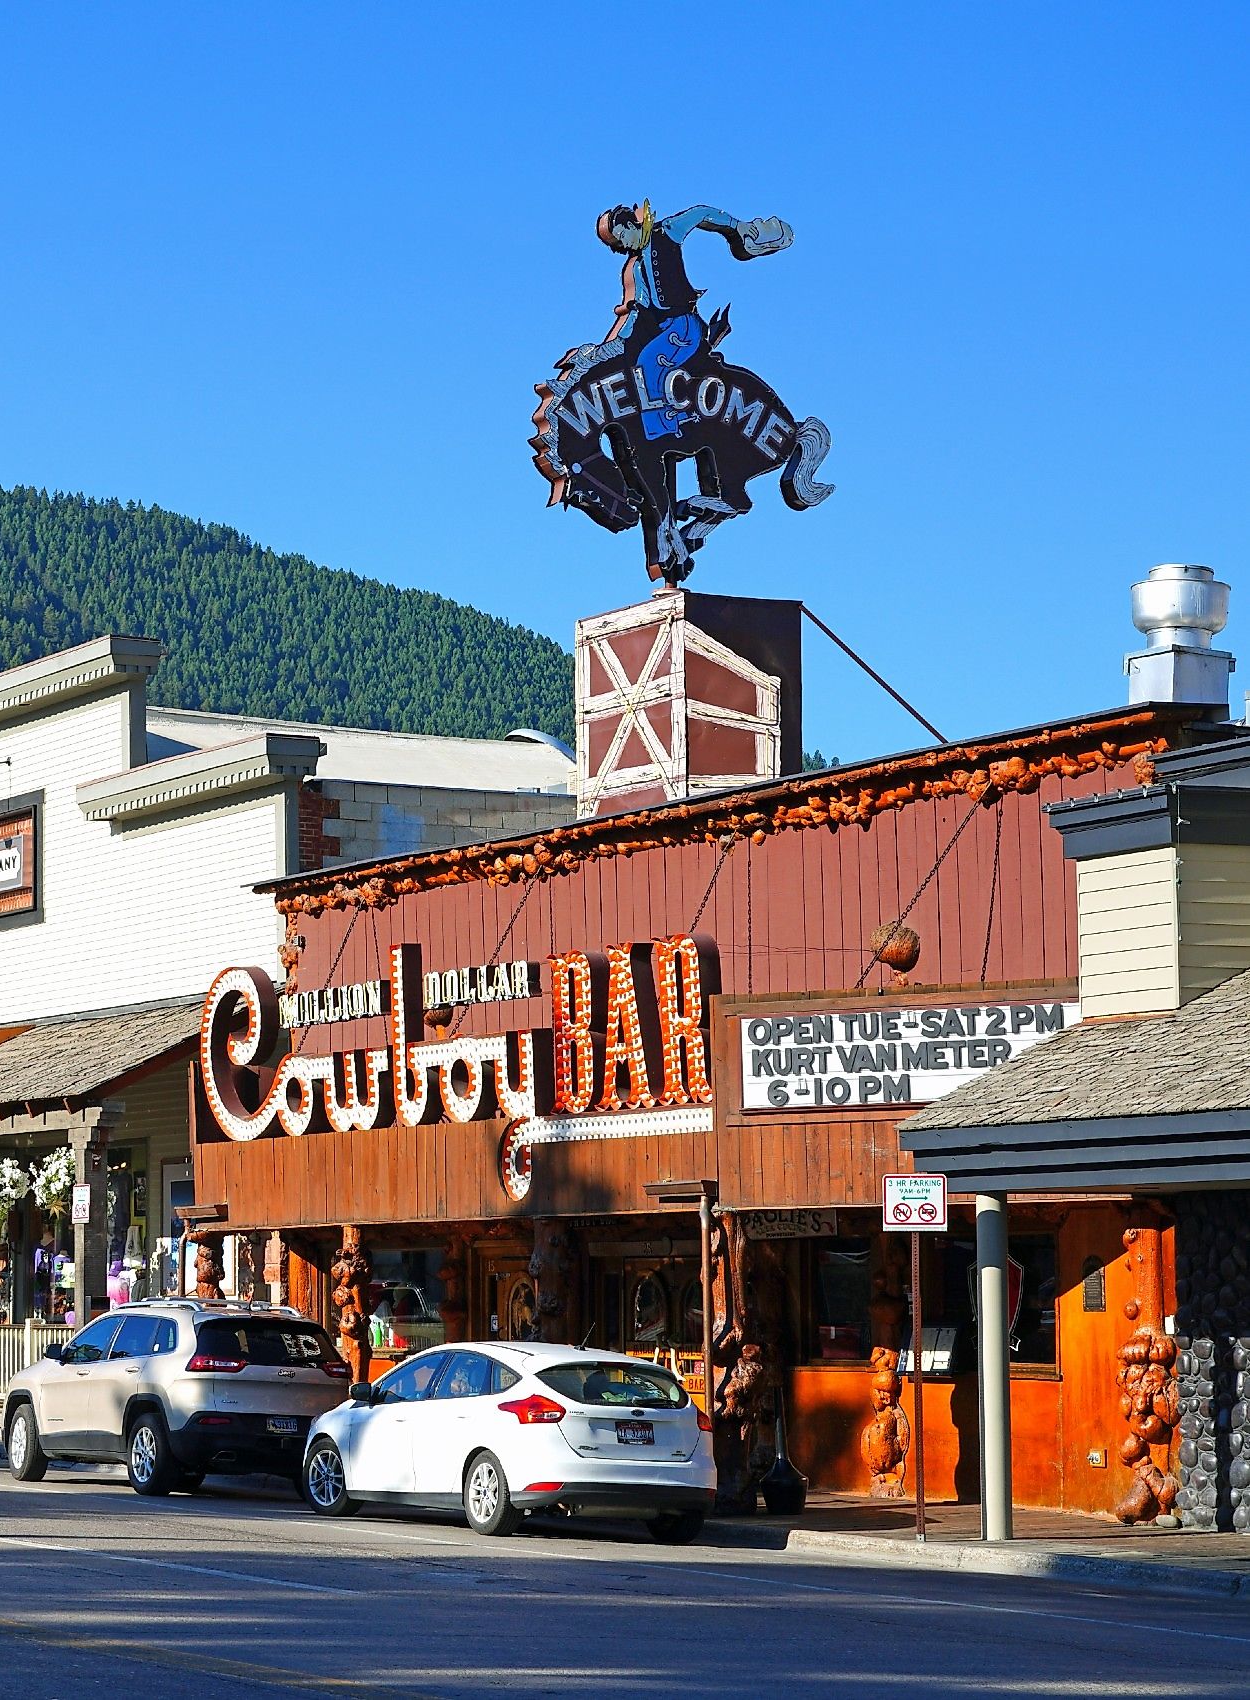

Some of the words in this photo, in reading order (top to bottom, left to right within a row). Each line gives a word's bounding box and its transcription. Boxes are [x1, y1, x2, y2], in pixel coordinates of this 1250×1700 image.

[556, 367, 798, 460] WELCOME
[279, 980, 382, 1029] MILLION
[422, 959, 530, 1009] DOLLAR
[549, 933, 715, 1113] BAR
[747, 1015, 834, 1046] OPEN
[751, 1046, 831, 1077] KURT
[835, 1042, 897, 1073] VAN
[902, 1038, 1012, 1071] METER
[859, 1073, 911, 1102] PM
